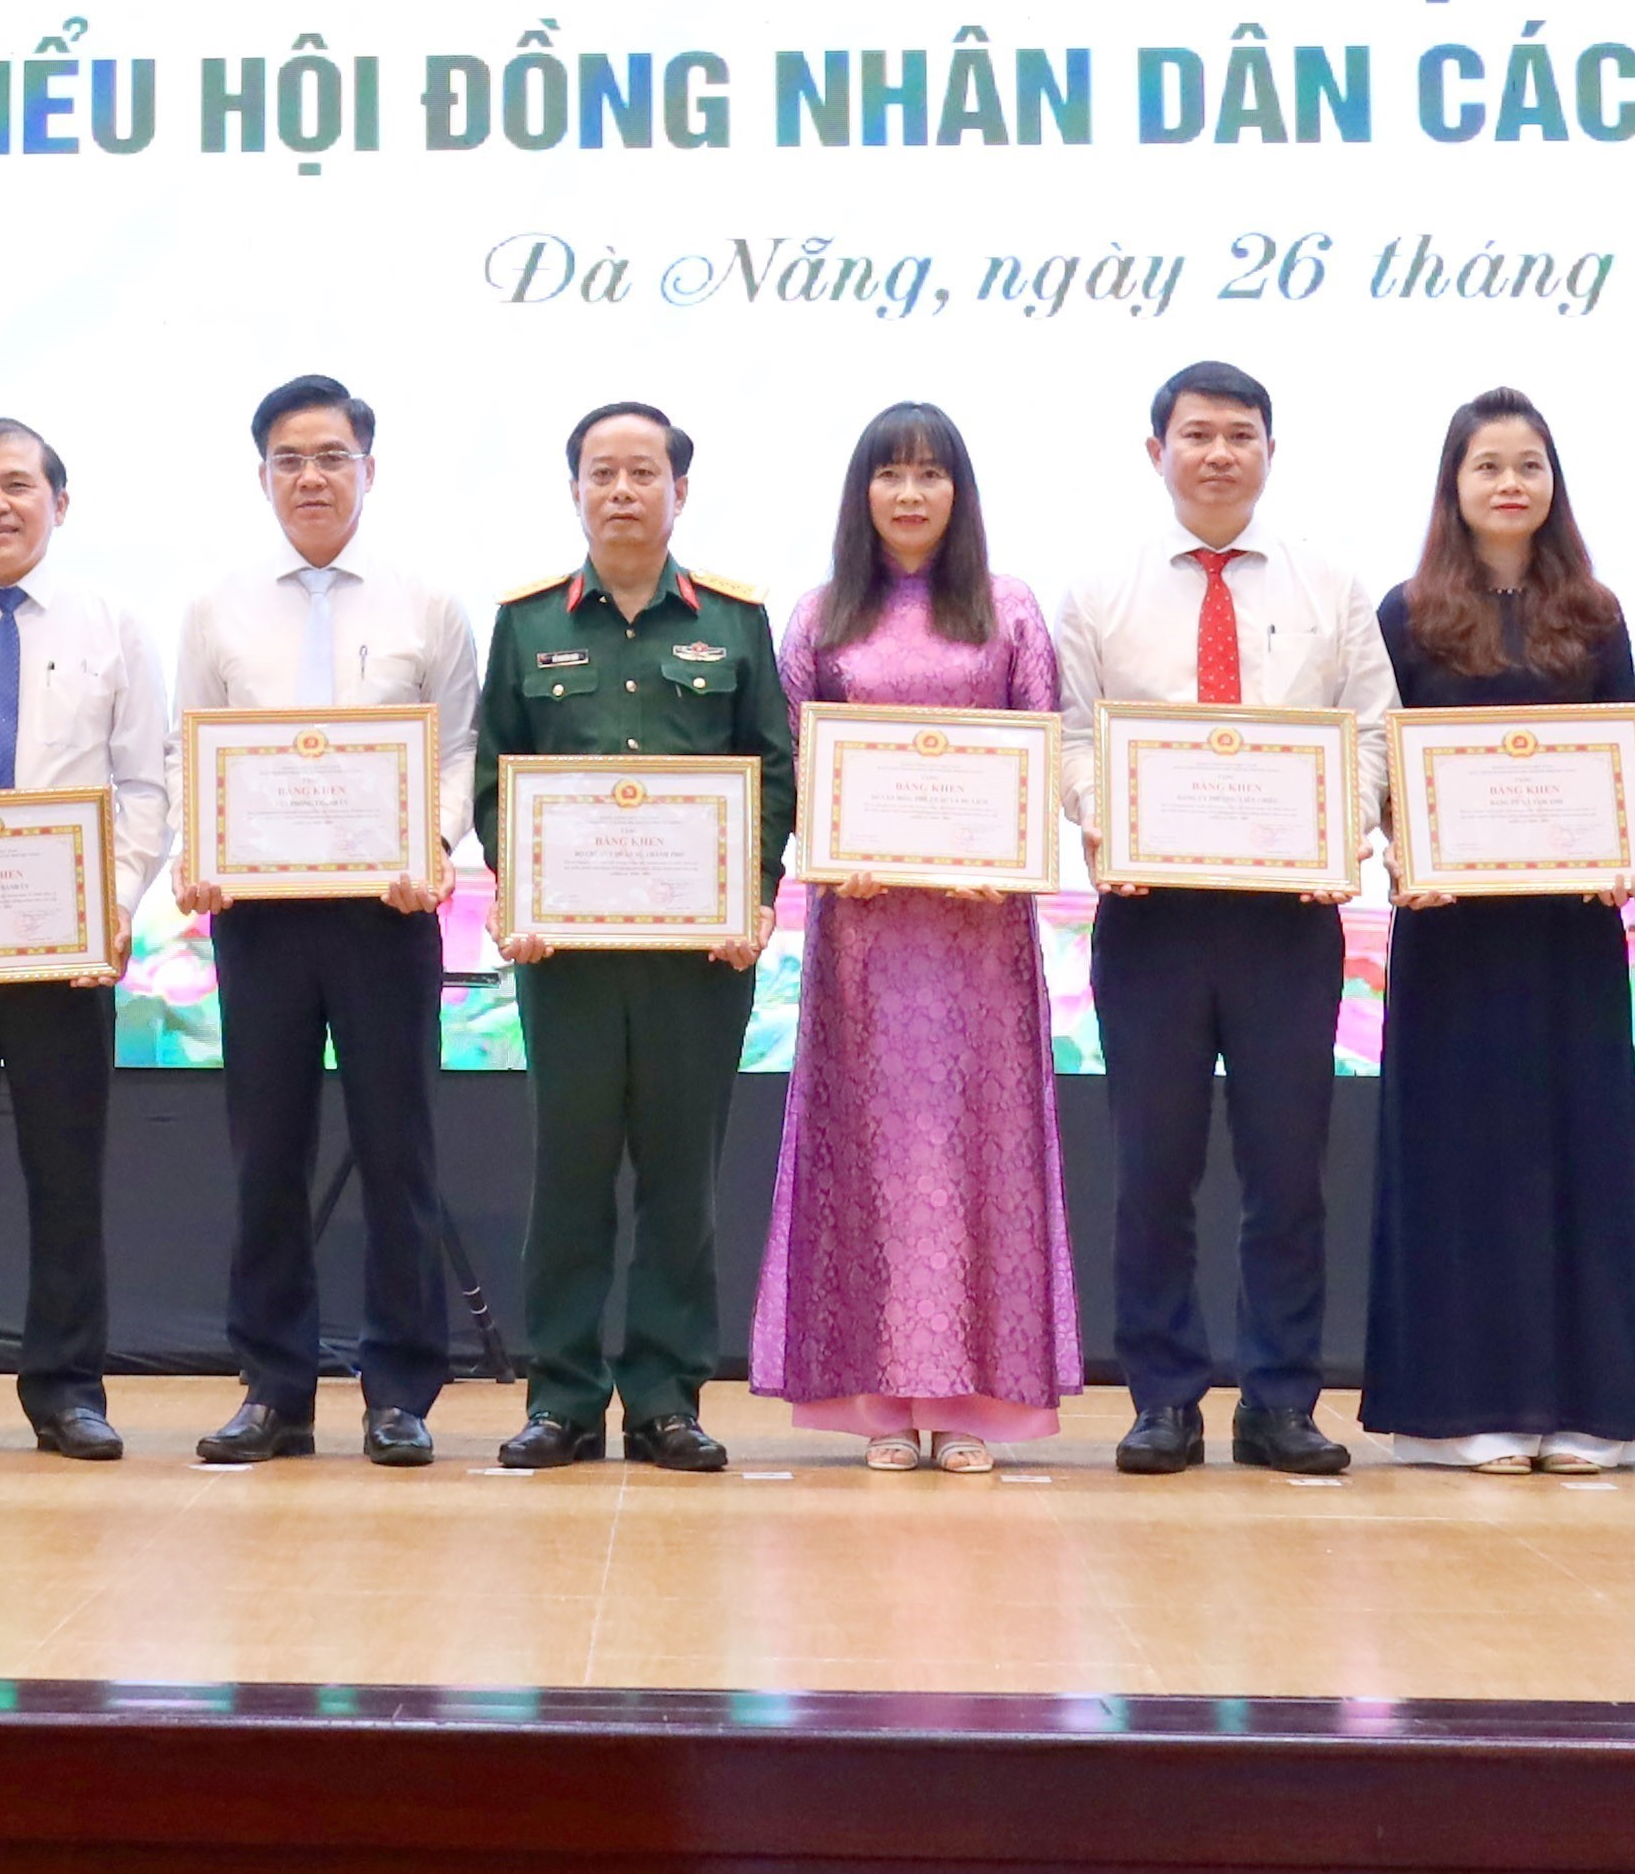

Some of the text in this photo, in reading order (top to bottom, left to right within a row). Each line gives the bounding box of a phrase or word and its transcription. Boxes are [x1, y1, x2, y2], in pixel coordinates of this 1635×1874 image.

[201, 33, 379, 175] HỘI
[421, 18, 729, 151] ĐỒNG
[776, 26, 1092, 147] NHÂN
[1138, 23, 1372, 144] DÂN
[485, 234, 632, 303] Đà
[660, 236, 949, 318] Nẵng,
[977, 242, 1185, 317] ngày
[1217, 232, 1333, 300] 26
[1370, 234, 1615, 315] tháng
